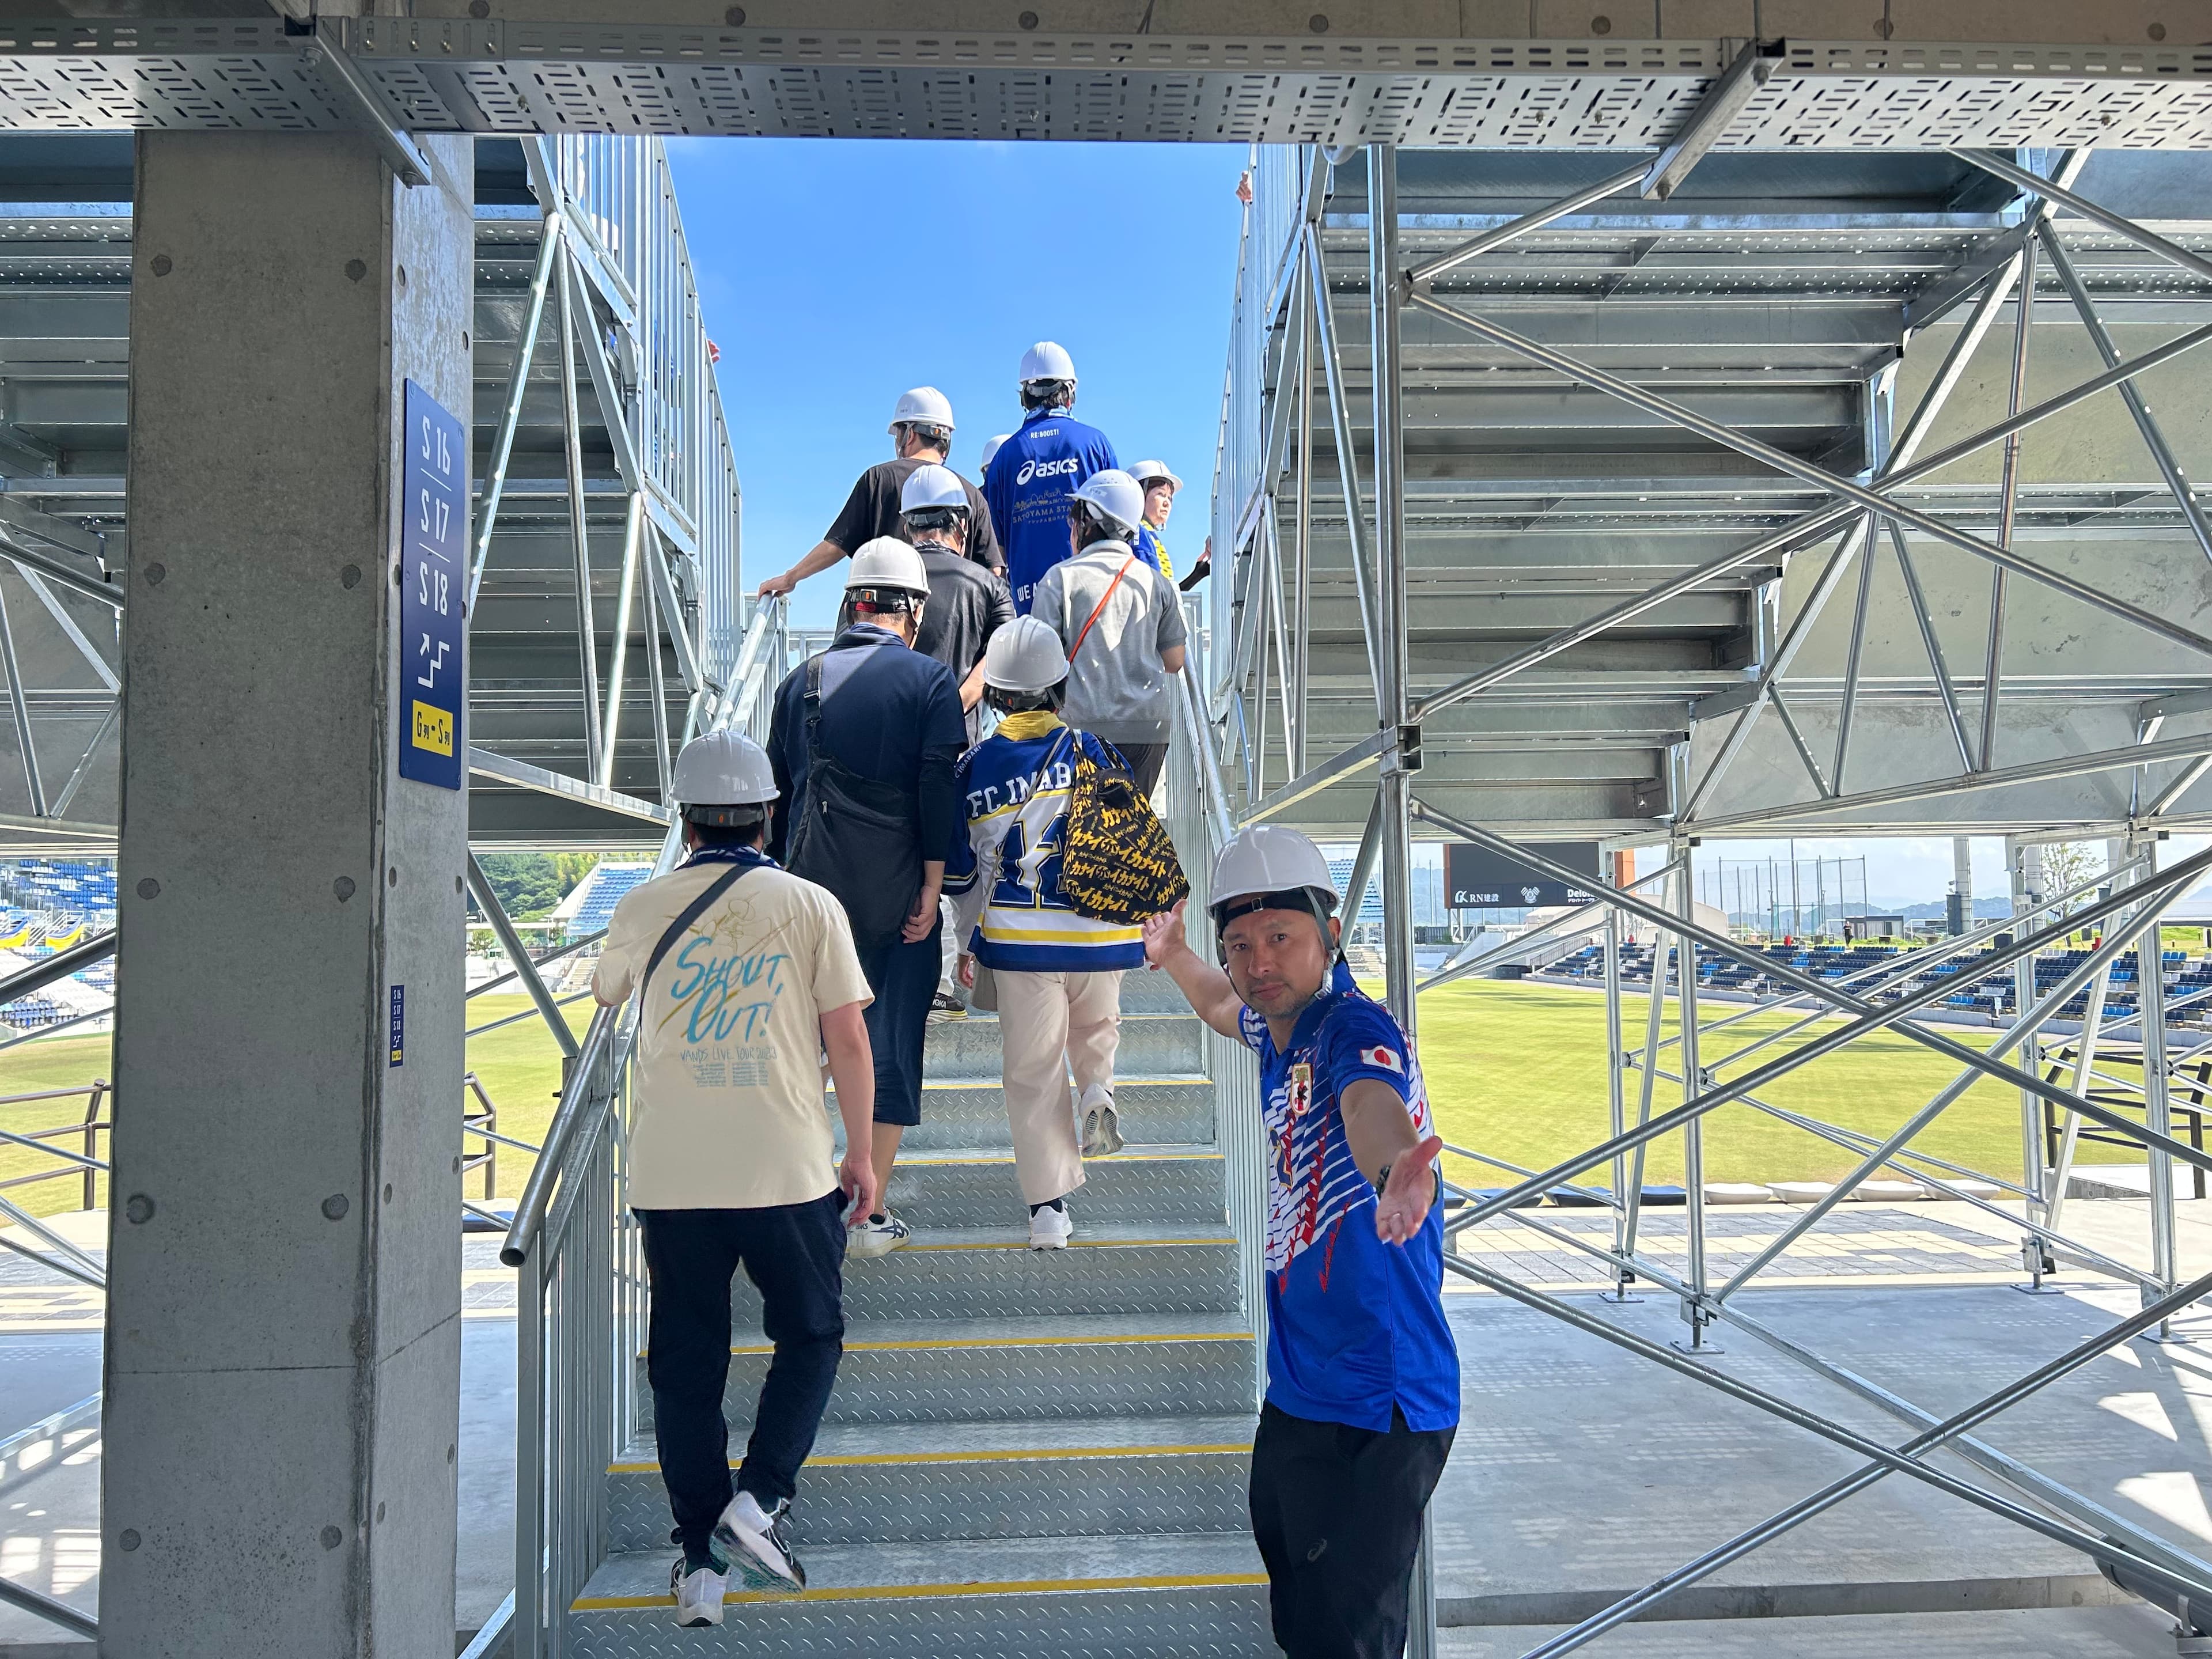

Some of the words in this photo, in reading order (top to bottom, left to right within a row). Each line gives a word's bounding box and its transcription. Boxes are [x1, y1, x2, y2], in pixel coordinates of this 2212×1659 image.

[437, 427, 450, 475] 16
[1035, 458, 1078, 478] asics
[436, 495, 449, 543] 17
[1013, 507, 1054, 524] SATOYAMA
[434, 569, 449, 616] 18
[1017, 584, 1031, 603] WE
[966, 785, 1001, 820] FC
[1005, 762, 1071, 805] IMAB
[671, 936, 792, 999] SHOUT
[687, 978, 784, 1045] OUT!
[680, 1048, 709, 1064] WANDS
[712, 1047, 734, 1060] LIVE
